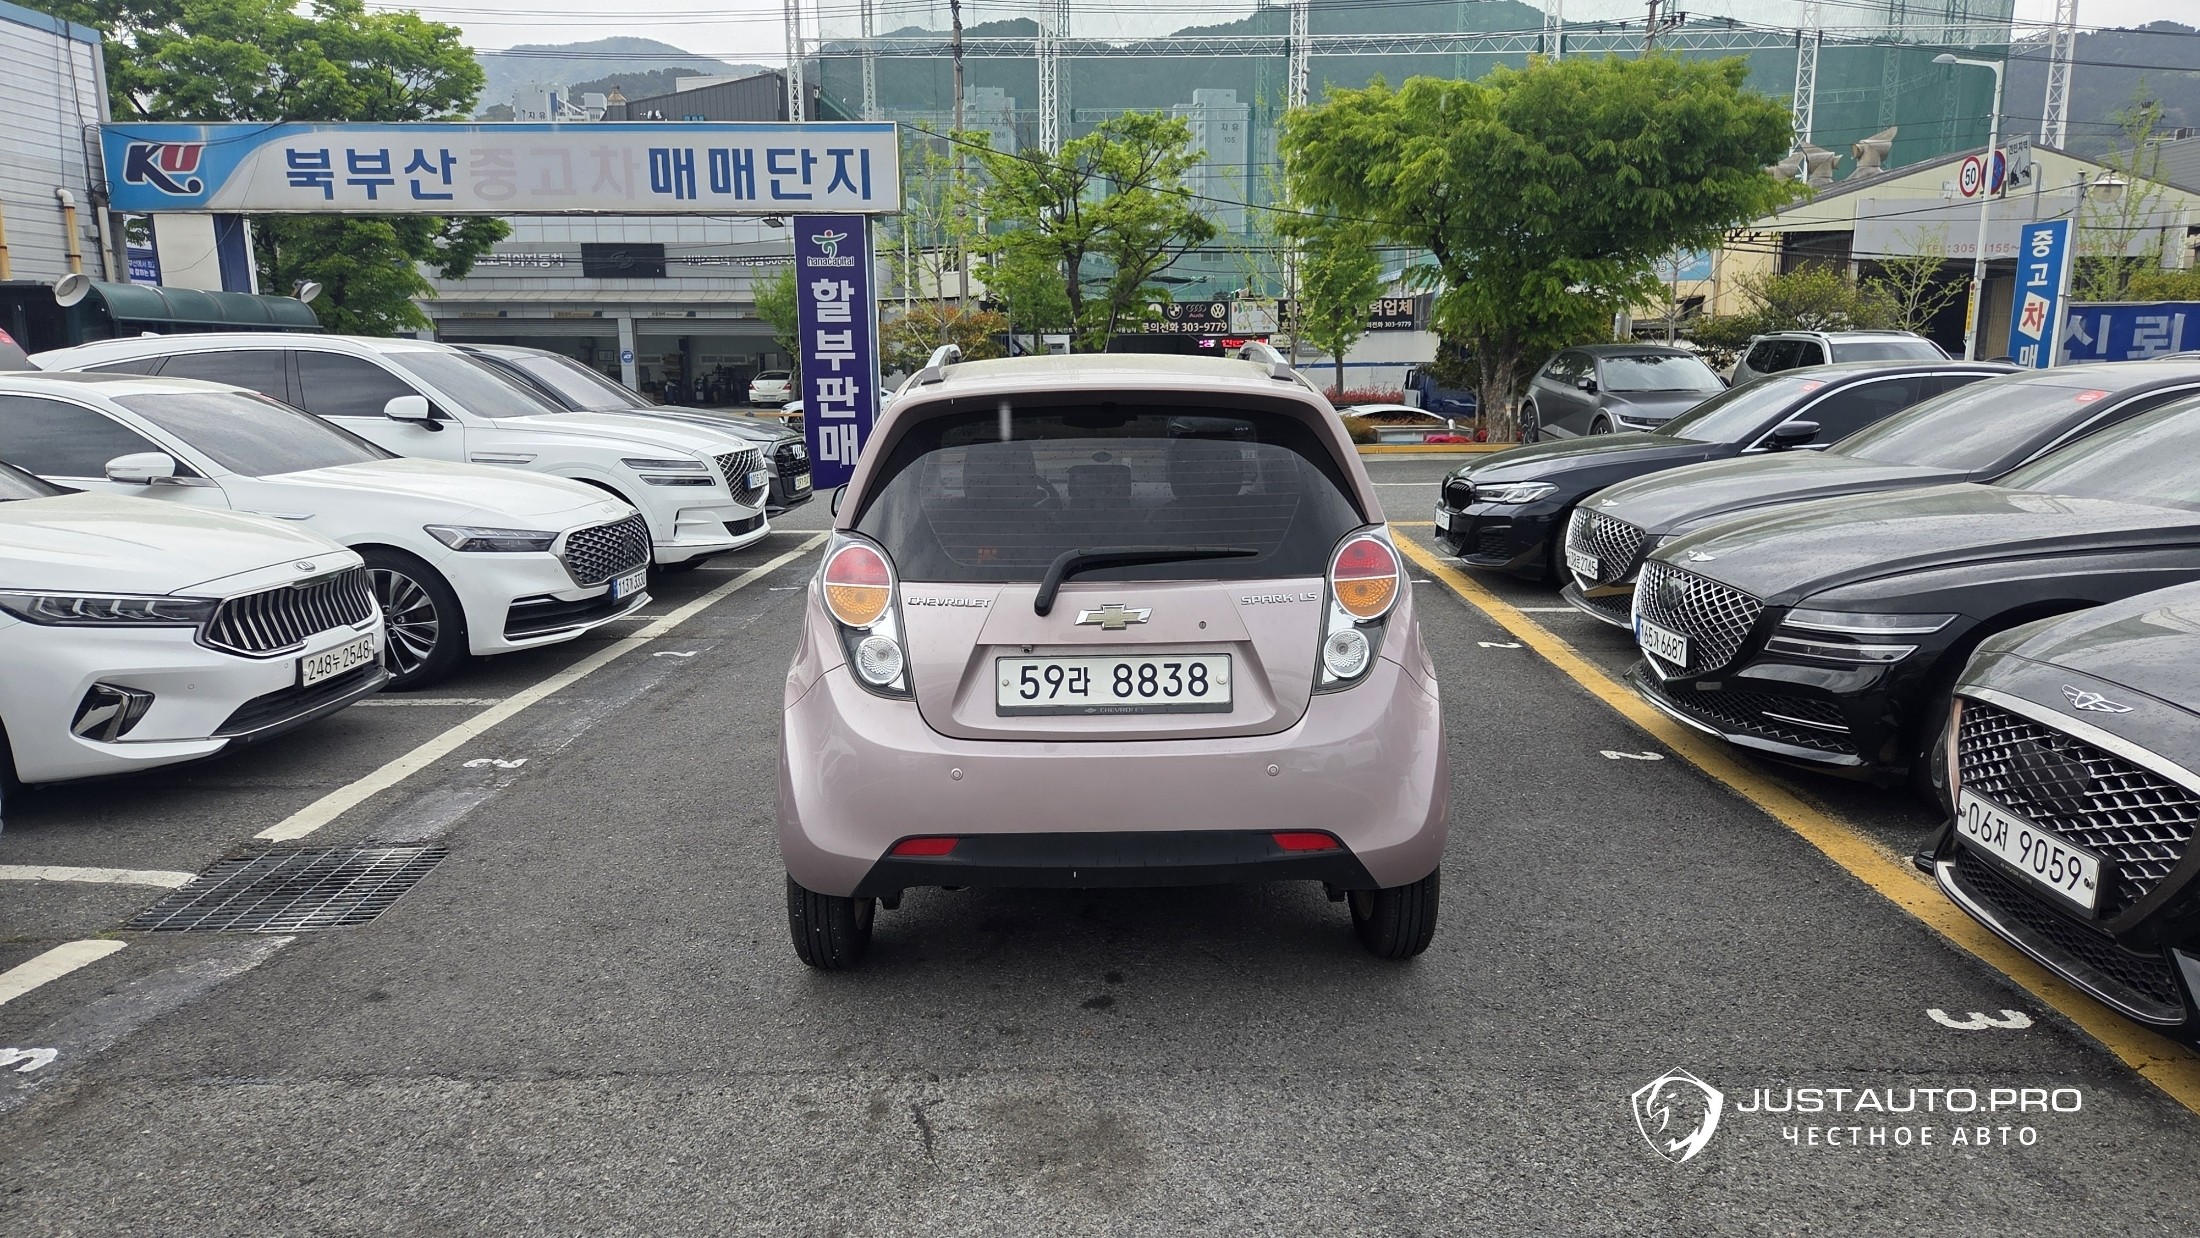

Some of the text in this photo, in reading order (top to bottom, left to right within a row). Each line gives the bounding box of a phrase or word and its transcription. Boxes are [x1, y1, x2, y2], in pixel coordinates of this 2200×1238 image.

[1220, 123, 1239, 132] 자유
[1223, 136, 1236, 144] 105
[2008, 140, 2028, 155] 견인지역
[126, 144, 203, 194] KU
[1965, 167, 1976, 186] 50
[807, 256, 855, 267] hanacapital
[1369, 299, 1412, 316] 력업체
[1181, 322, 1228, 332] 303-9779
[811, 278, 860, 466] 할부판매
[907, 596, 992, 608] CHEVROLET
[1241, 591, 1317, 605] SPARK LS
[1661, 633, 1684, 661] 6687
[308, 639, 370, 681] 248누 2548
[1019, 662, 1210, 700] 59라 8838
[1968, 802, 2082, 891] 06저 9059
